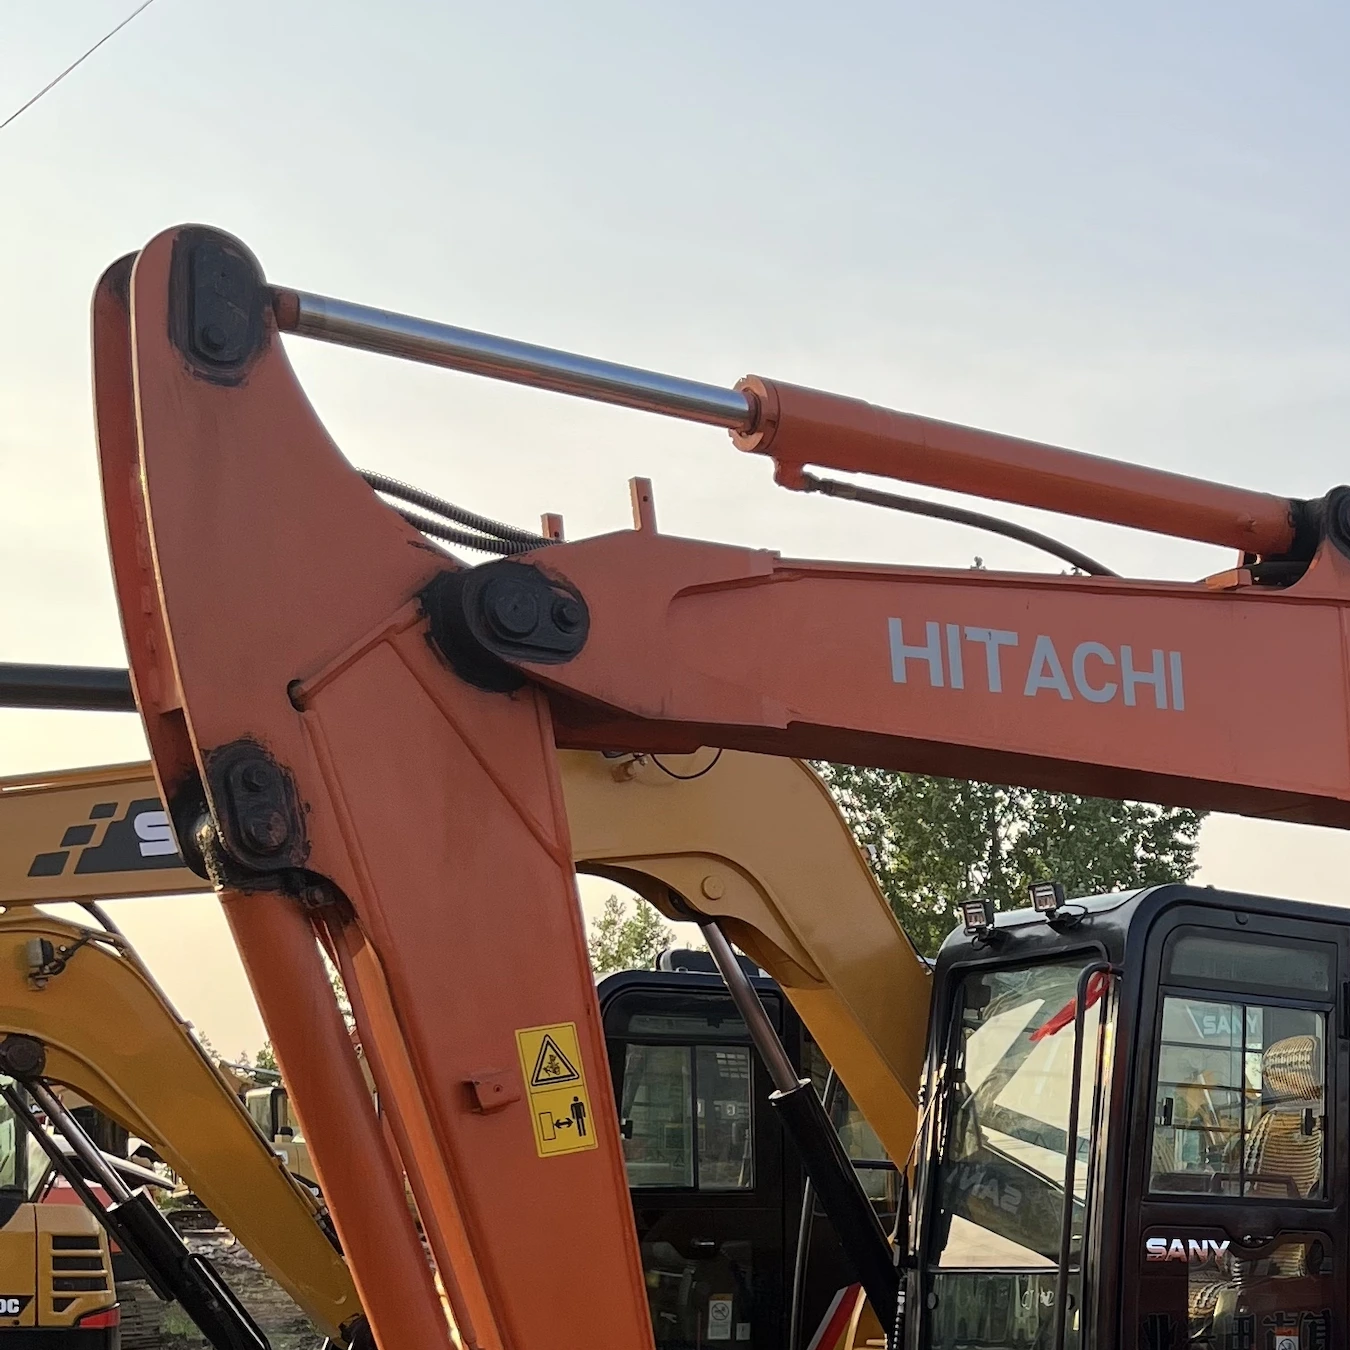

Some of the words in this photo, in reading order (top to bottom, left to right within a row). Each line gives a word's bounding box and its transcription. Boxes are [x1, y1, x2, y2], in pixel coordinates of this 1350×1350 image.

[888, 617, 1184, 711] HITACHI
[1203, 1014, 1257, 1035] SANY
[1146, 1237, 1230, 1263] SANY
